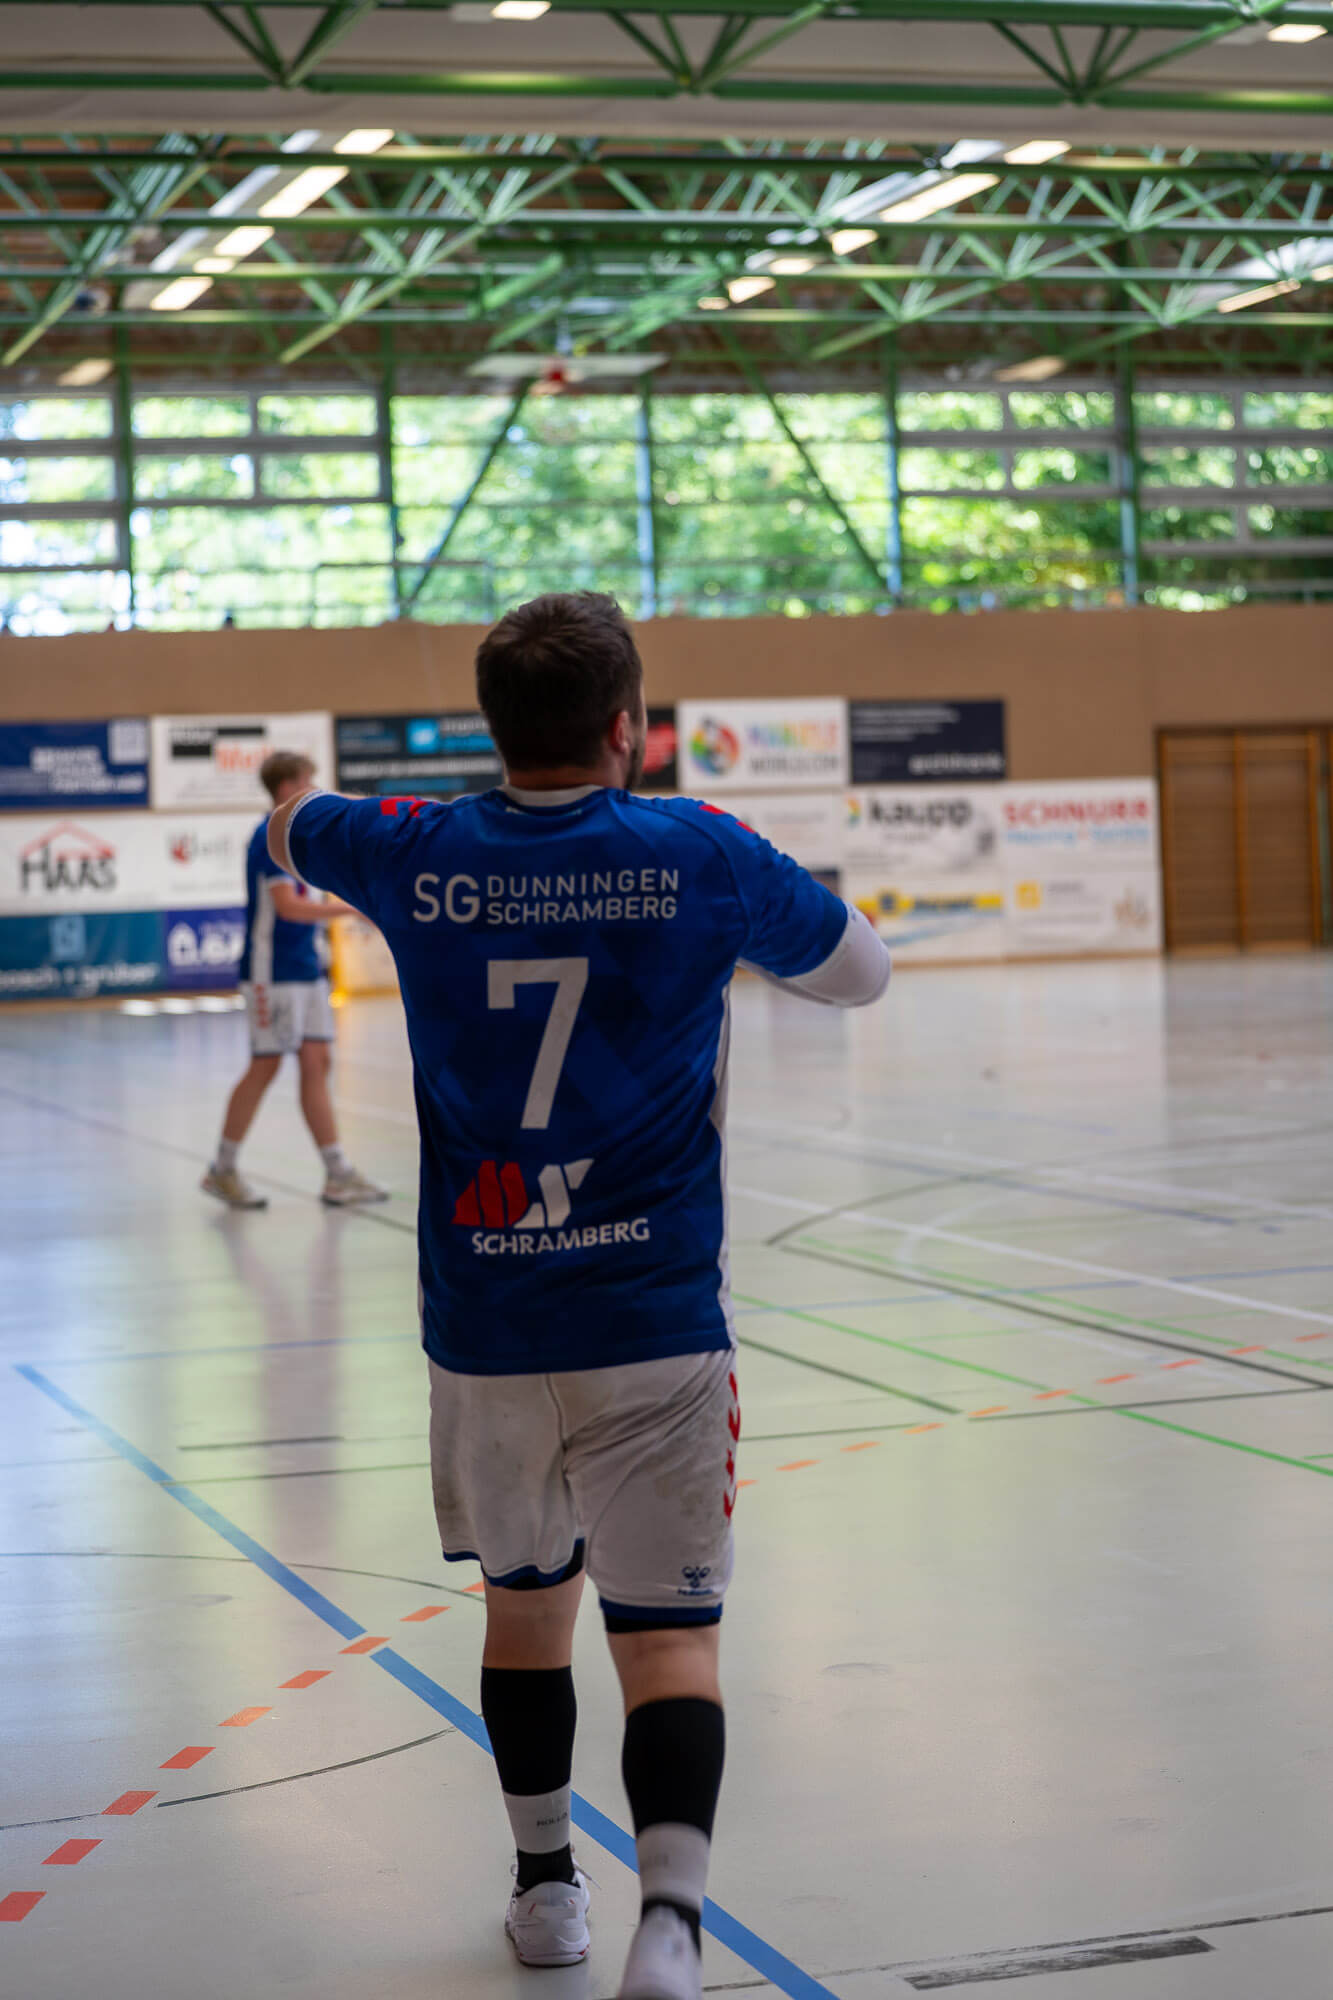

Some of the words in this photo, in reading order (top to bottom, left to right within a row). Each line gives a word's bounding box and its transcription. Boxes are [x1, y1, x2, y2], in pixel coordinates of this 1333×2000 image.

[20, 842, 117, 893] HAAS
[413, 873, 480, 923] SG
[487, 868, 679, 897] DUNNINGEN
[487, 896, 677, 925] SCHRAMBERG
[487, 957, 589, 1130] 7
[472, 1218, 650, 1255] SCHRAMBERG
